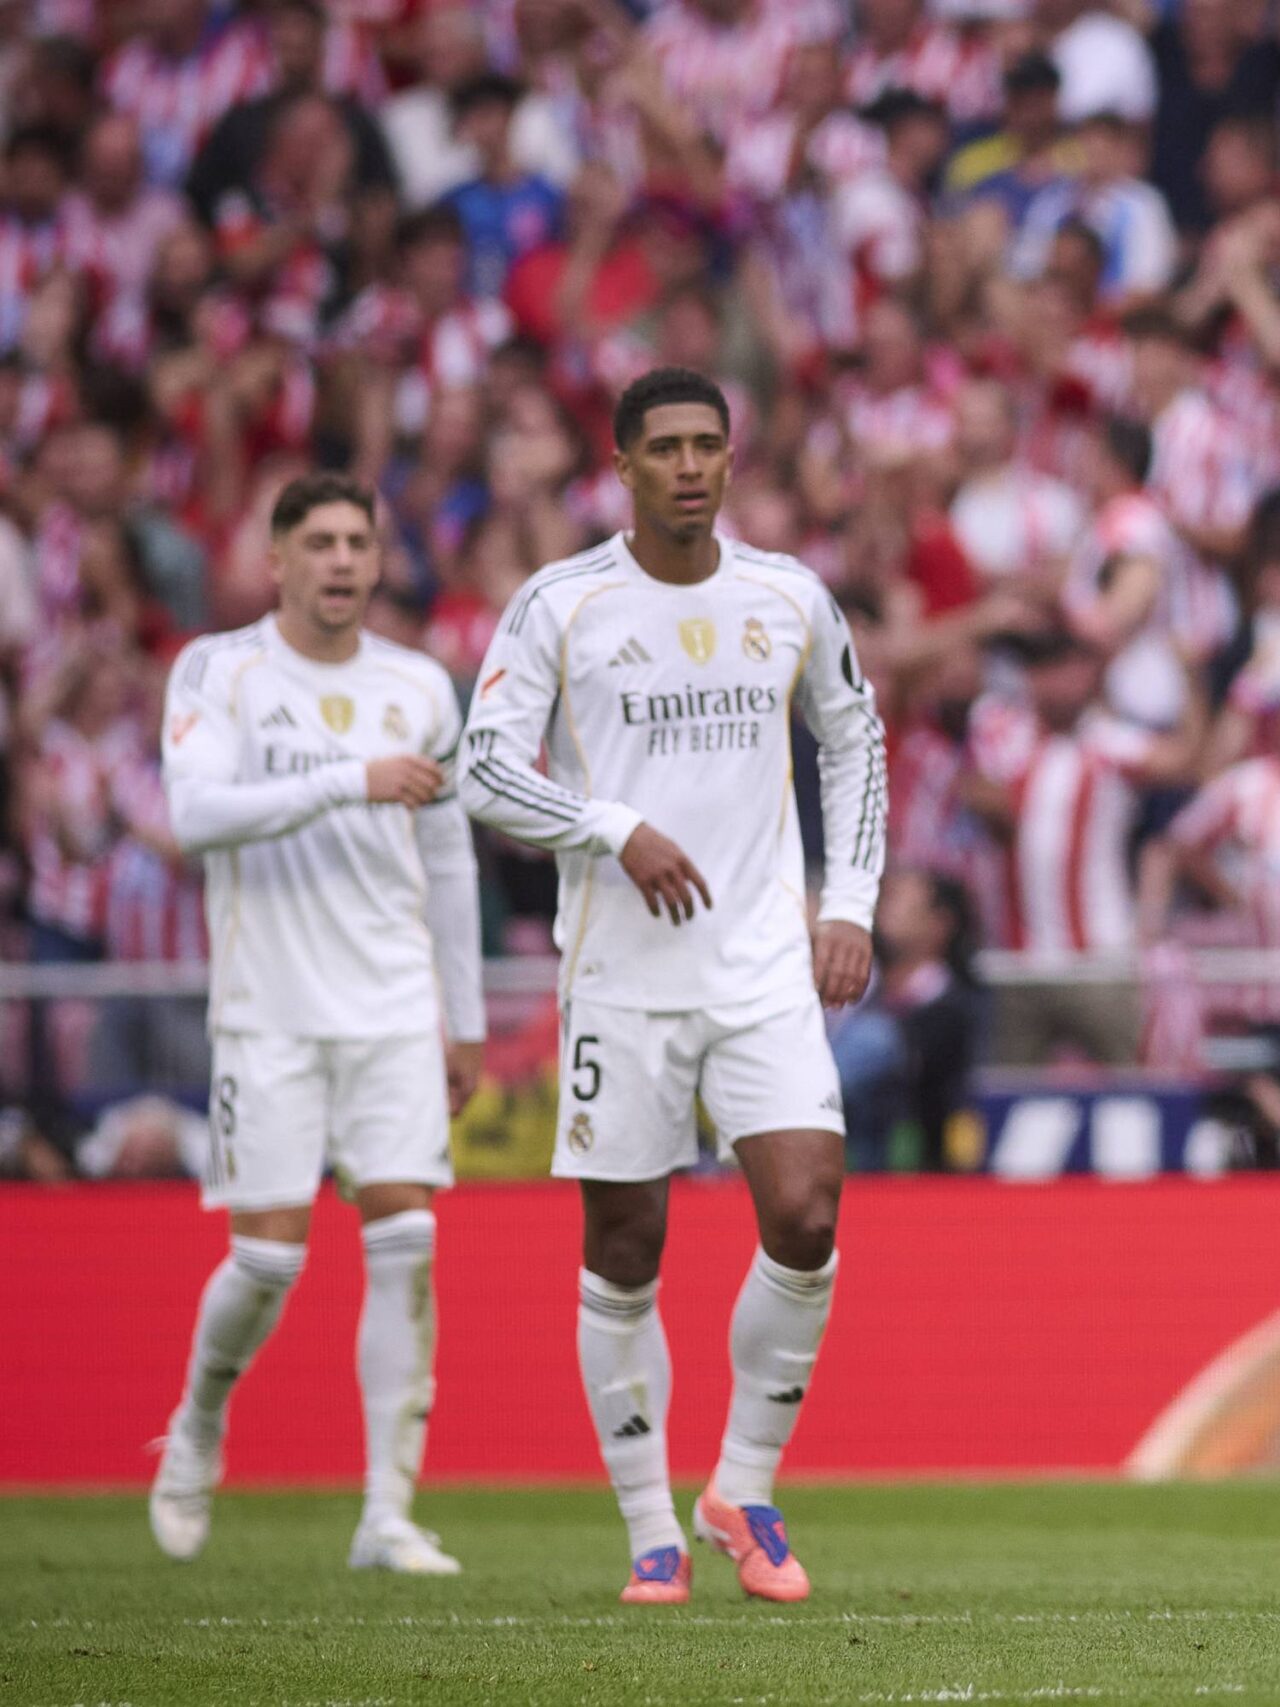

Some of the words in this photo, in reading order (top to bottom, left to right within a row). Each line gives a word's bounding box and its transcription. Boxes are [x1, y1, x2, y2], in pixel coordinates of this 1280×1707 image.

[620, 684, 776, 725] Emirates
[649, 727, 681, 756] FLY
[690, 722, 759, 752] BETTER
[572, 1036, 600, 1101] 5
